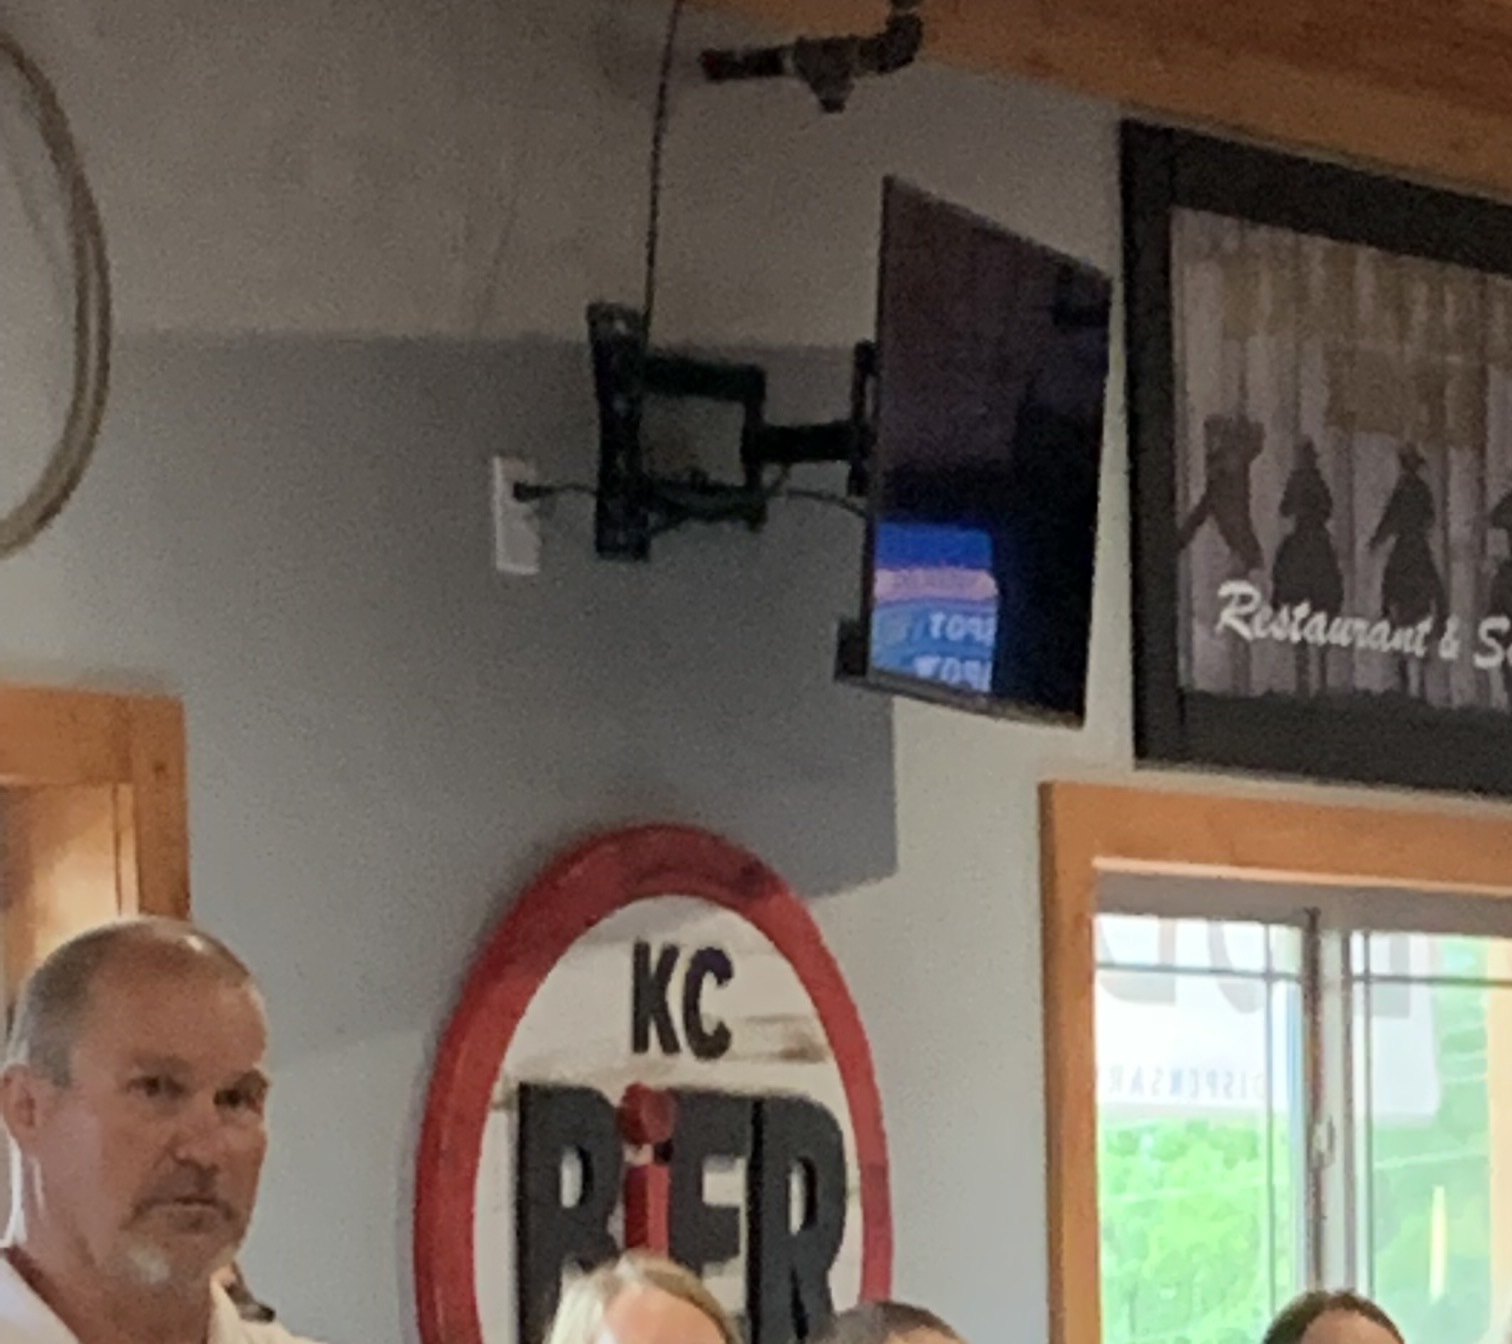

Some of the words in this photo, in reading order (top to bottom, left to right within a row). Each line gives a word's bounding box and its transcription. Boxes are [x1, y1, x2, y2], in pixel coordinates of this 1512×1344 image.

[1215, 580, 1434, 658] Restaurant
[1438, 614, 1460, 660] &
[631, 938, 733, 1060] KC
